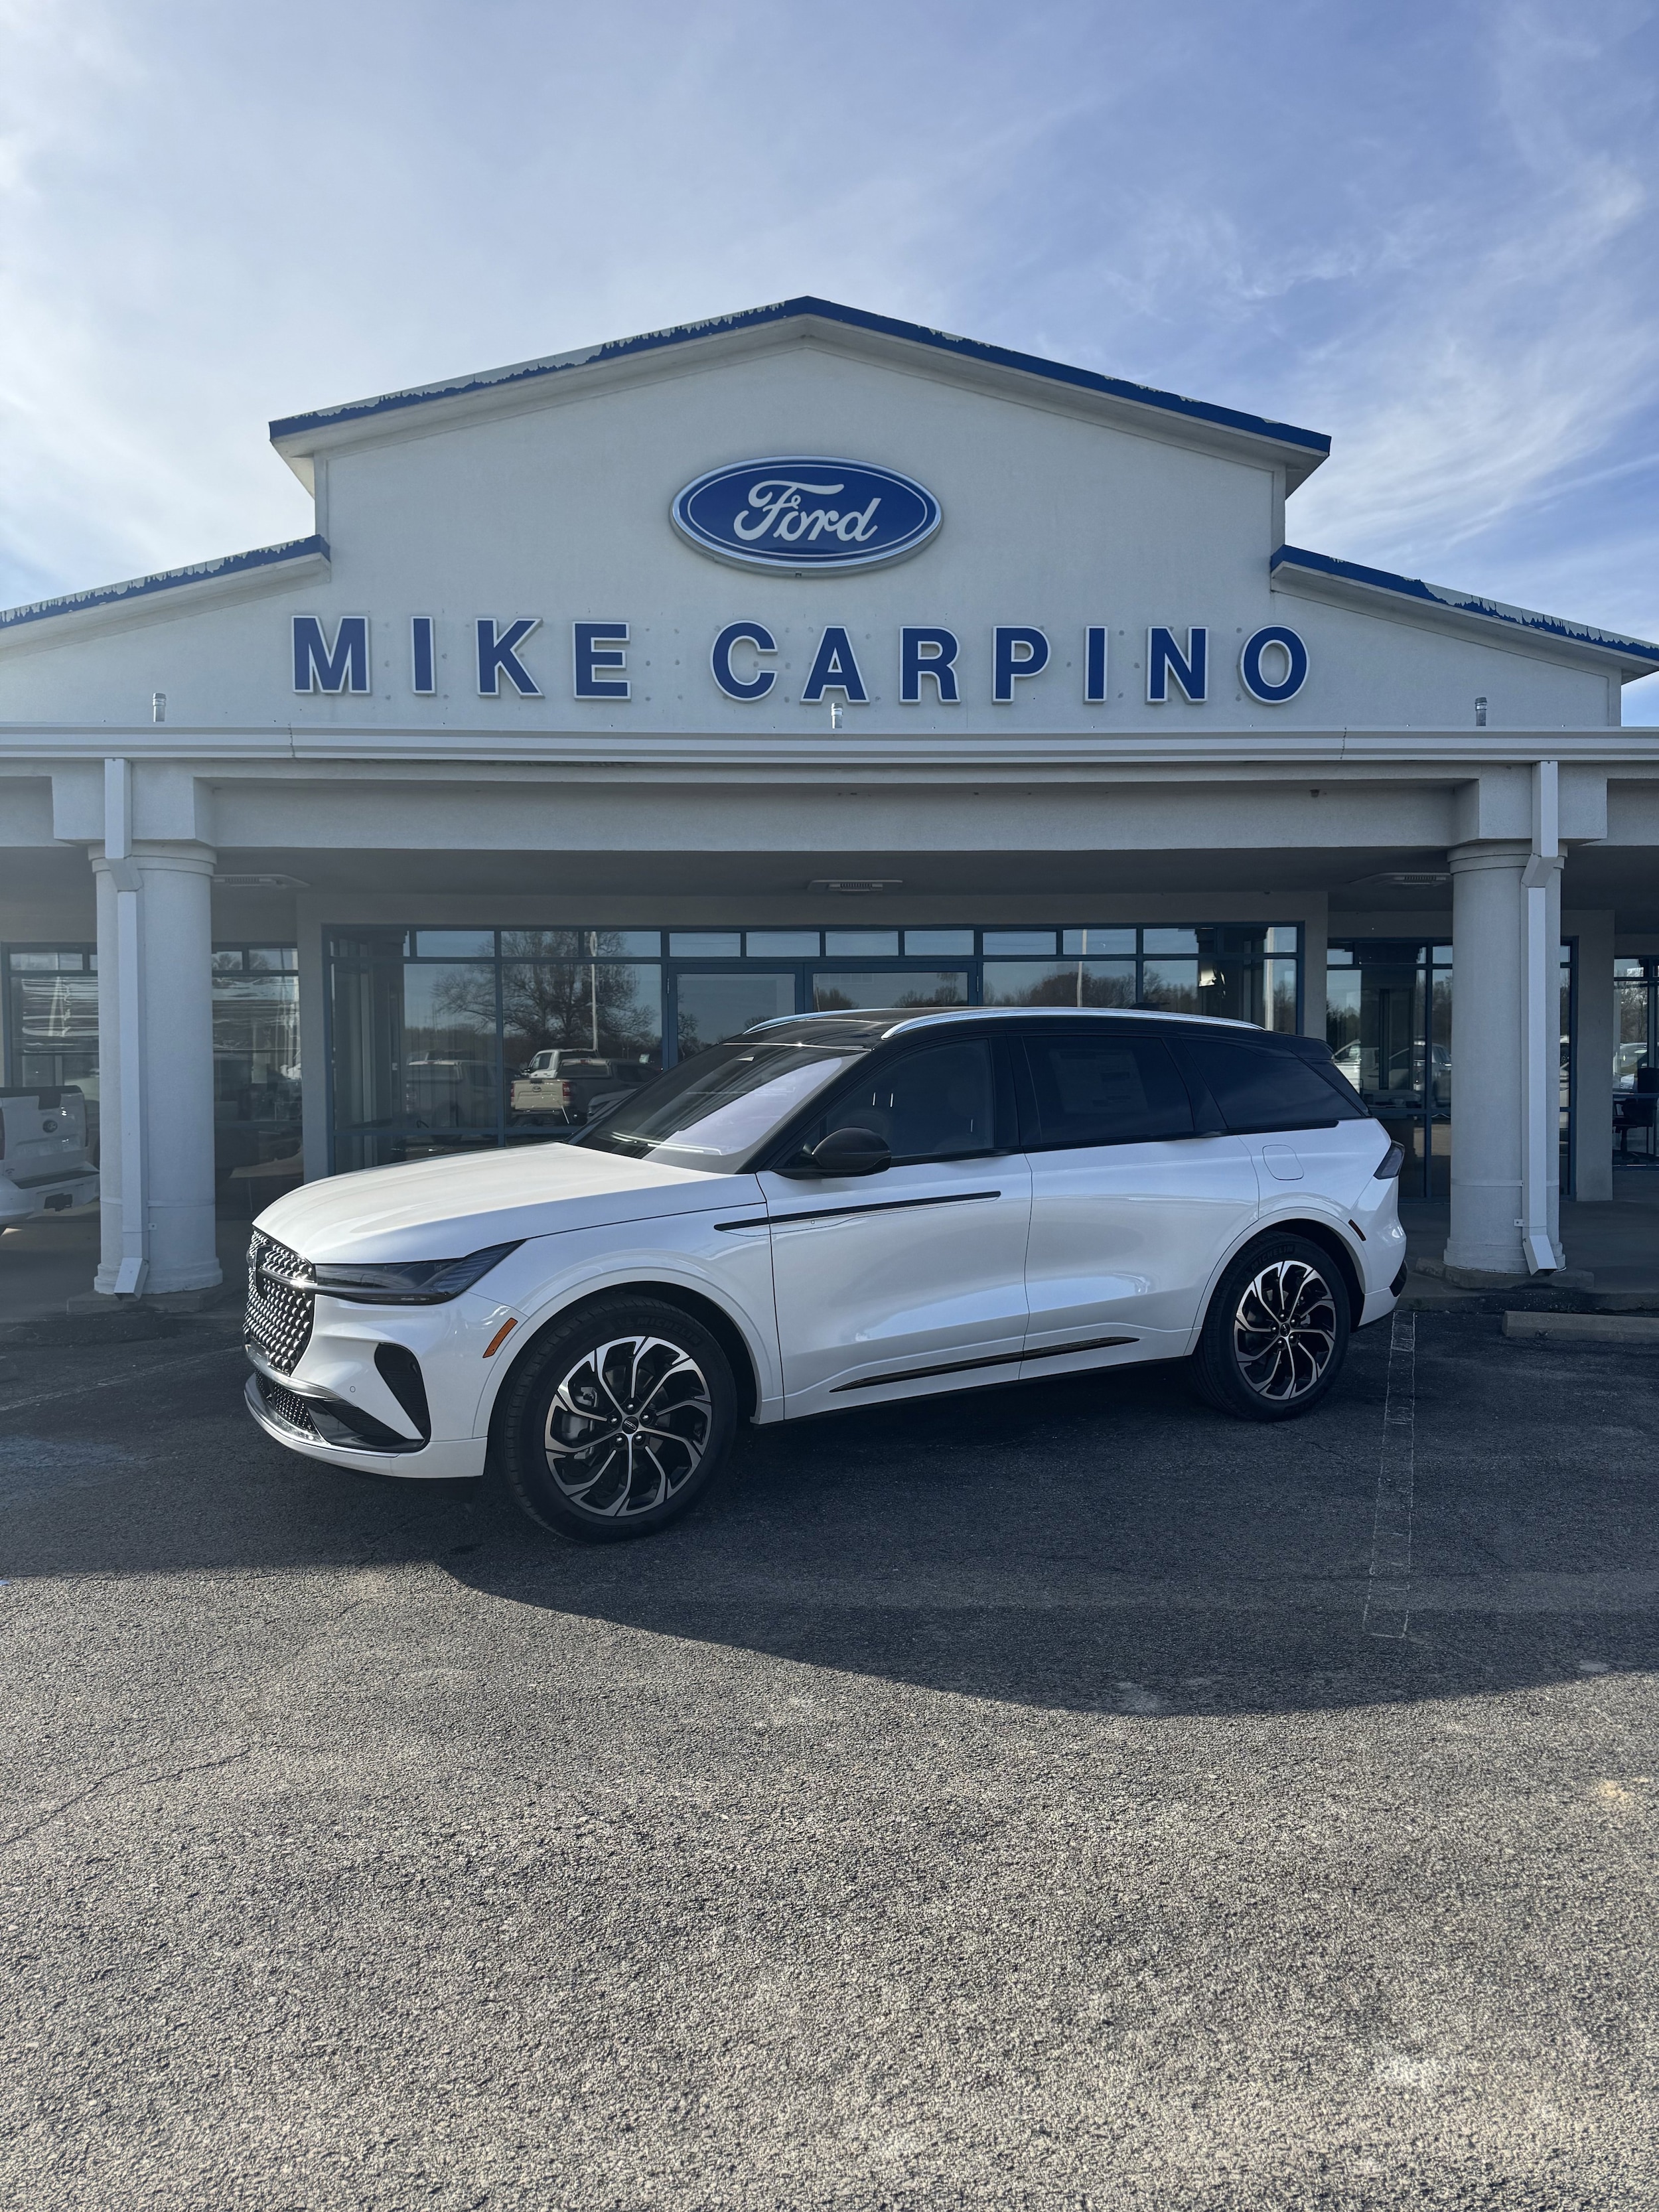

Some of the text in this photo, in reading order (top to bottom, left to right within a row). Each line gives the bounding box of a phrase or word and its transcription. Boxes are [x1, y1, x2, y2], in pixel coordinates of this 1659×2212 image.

[733, 480, 882, 542] Ford
[291, 615, 1311, 706] MIKE CARPINO
[1250, 1245, 1294, 1272] MICHELIN
[636, 1316, 701, 1345] MICHELIN
